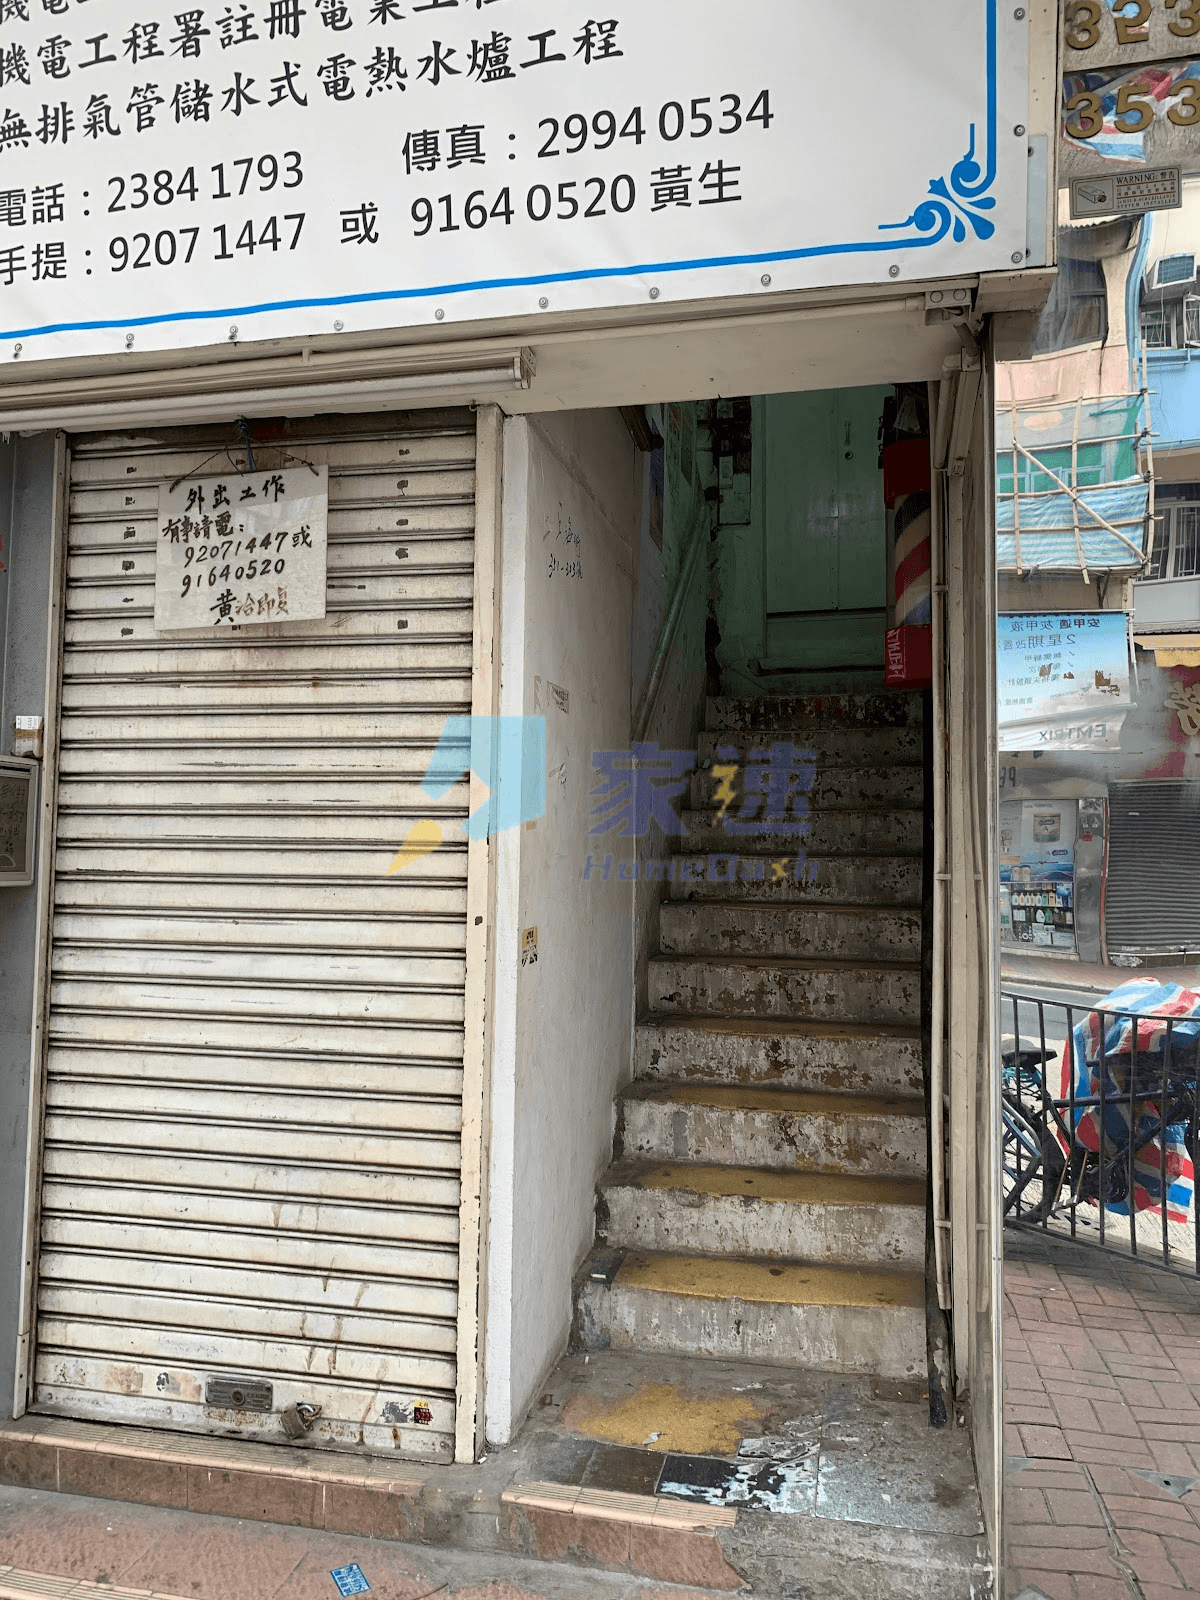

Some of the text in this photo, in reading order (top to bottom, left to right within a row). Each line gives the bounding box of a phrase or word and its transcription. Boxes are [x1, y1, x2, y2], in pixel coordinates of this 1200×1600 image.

[0, 0, 500, 87] 機電工程署註冊電業
[537, 106, 646, 158] 2994
[658, 89, 774, 141] 0534
[1066, 79, 1200, 139] 353
[107, 166, 199, 213] 2384
[211, 151, 304, 199] 1793
[1116, 173, 1158, 184] WARNING:
[109, 227, 200, 272] 9207
[213, 212, 306, 260] 1447
[340, 203, 380, 246] 或
[411, 187, 515, 236] 9164
[526, 174, 636, 221] 0520
[181, 559, 285, 598] 91640520
